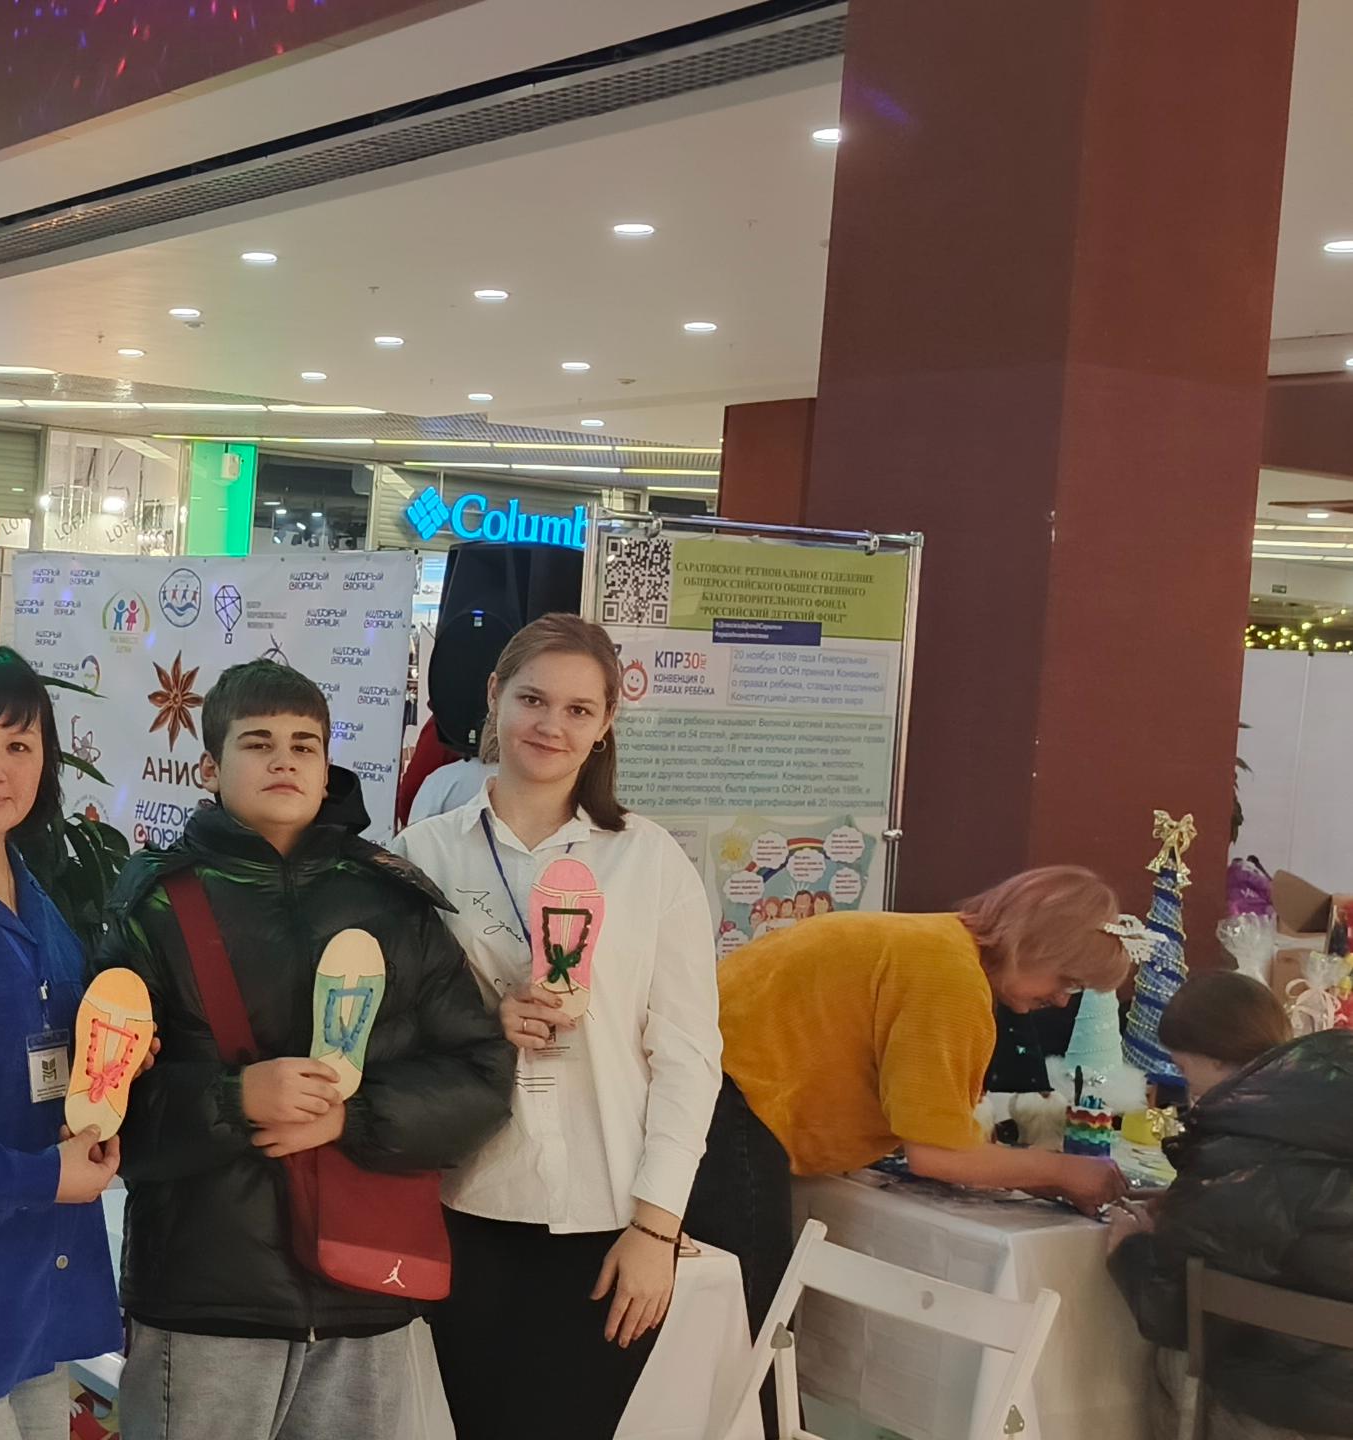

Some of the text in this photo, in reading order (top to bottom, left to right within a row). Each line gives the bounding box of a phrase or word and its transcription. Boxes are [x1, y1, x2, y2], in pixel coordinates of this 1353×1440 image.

[451, 494, 587, 548] Columb
[676, 561, 874, 583] САРАТОВСКОЕ РЕГИОНАЛЬНОЕ ОТДЕЛЕНИЕ
[684, 576, 866, 596] ОБЩЕРОССИЙСКОГО ОБЩЕСТВЕННОГО
[702, 592, 847, 609] БЛАГОТВОРИТЕЛЬНОГО ФОНДА
[770, 609, 814, 620] ДЕТСКИЙ
[654, 674, 698, 684] КОНВЕНЦИЯ
[653, 685, 682, 695] ПРАВАХ
[135, 799, 194, 827] #ЩЕДР
